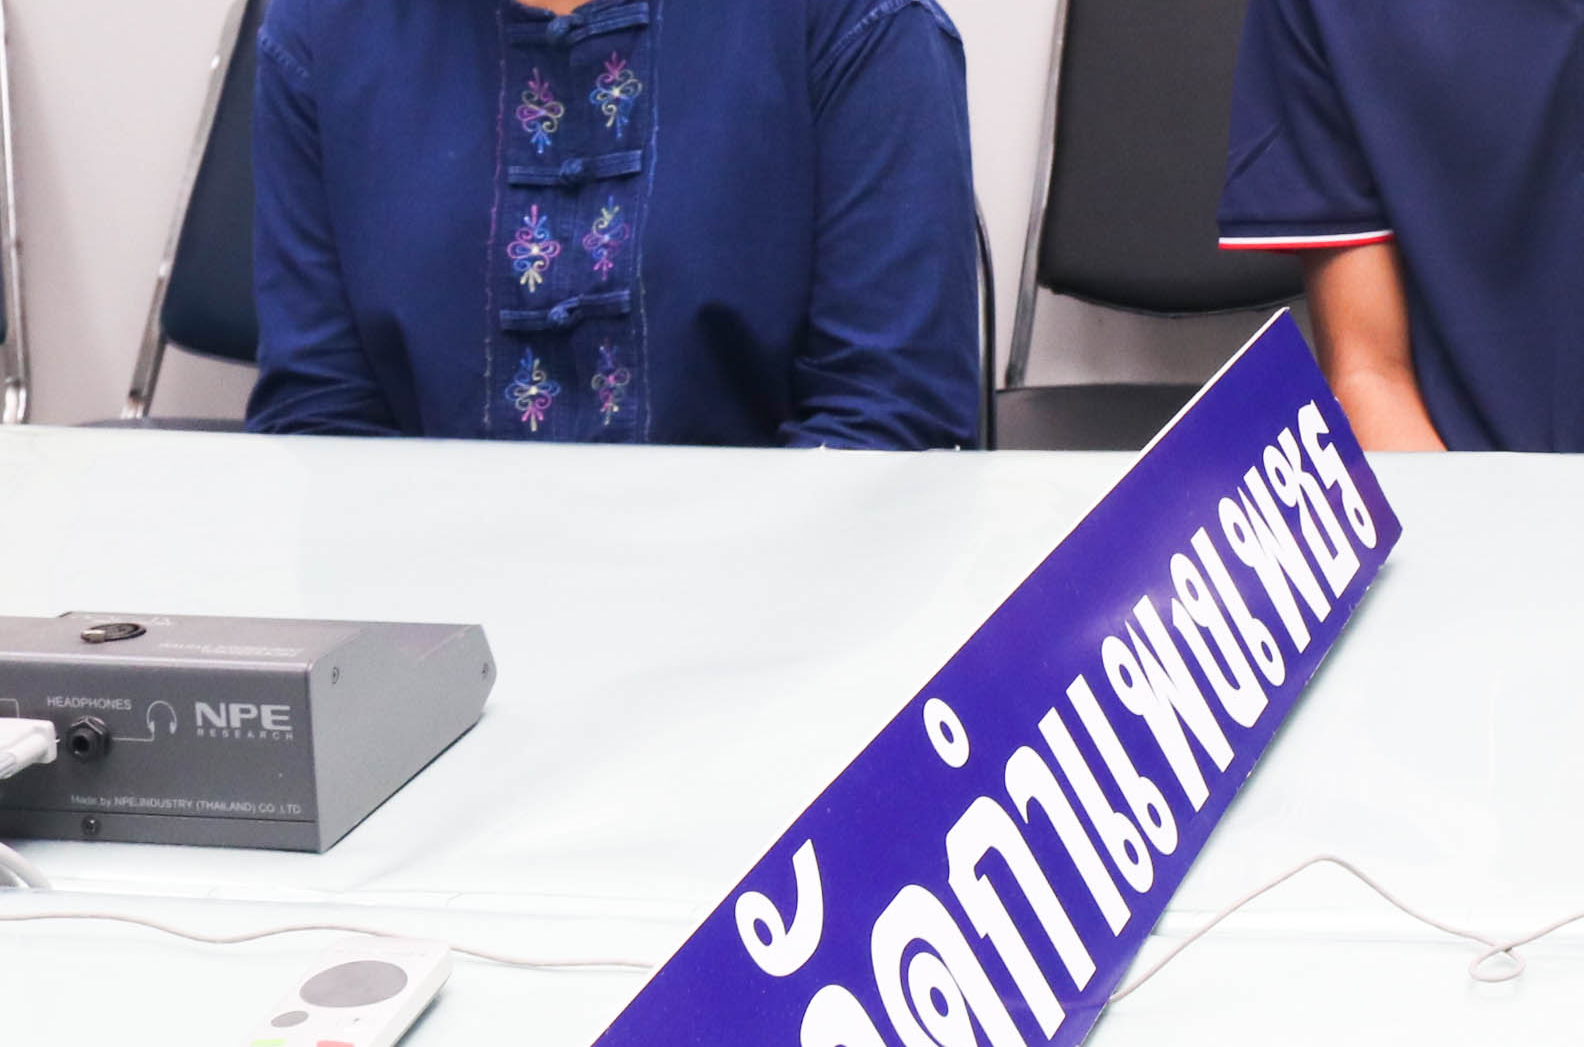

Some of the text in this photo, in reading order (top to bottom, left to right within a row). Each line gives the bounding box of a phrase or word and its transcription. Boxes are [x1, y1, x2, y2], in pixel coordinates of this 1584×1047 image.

[47, 696, 132, 711] HEADPHONES
[195, 702, 293, 731] NPE
[196, 729, 294, 742] RESEARCH
